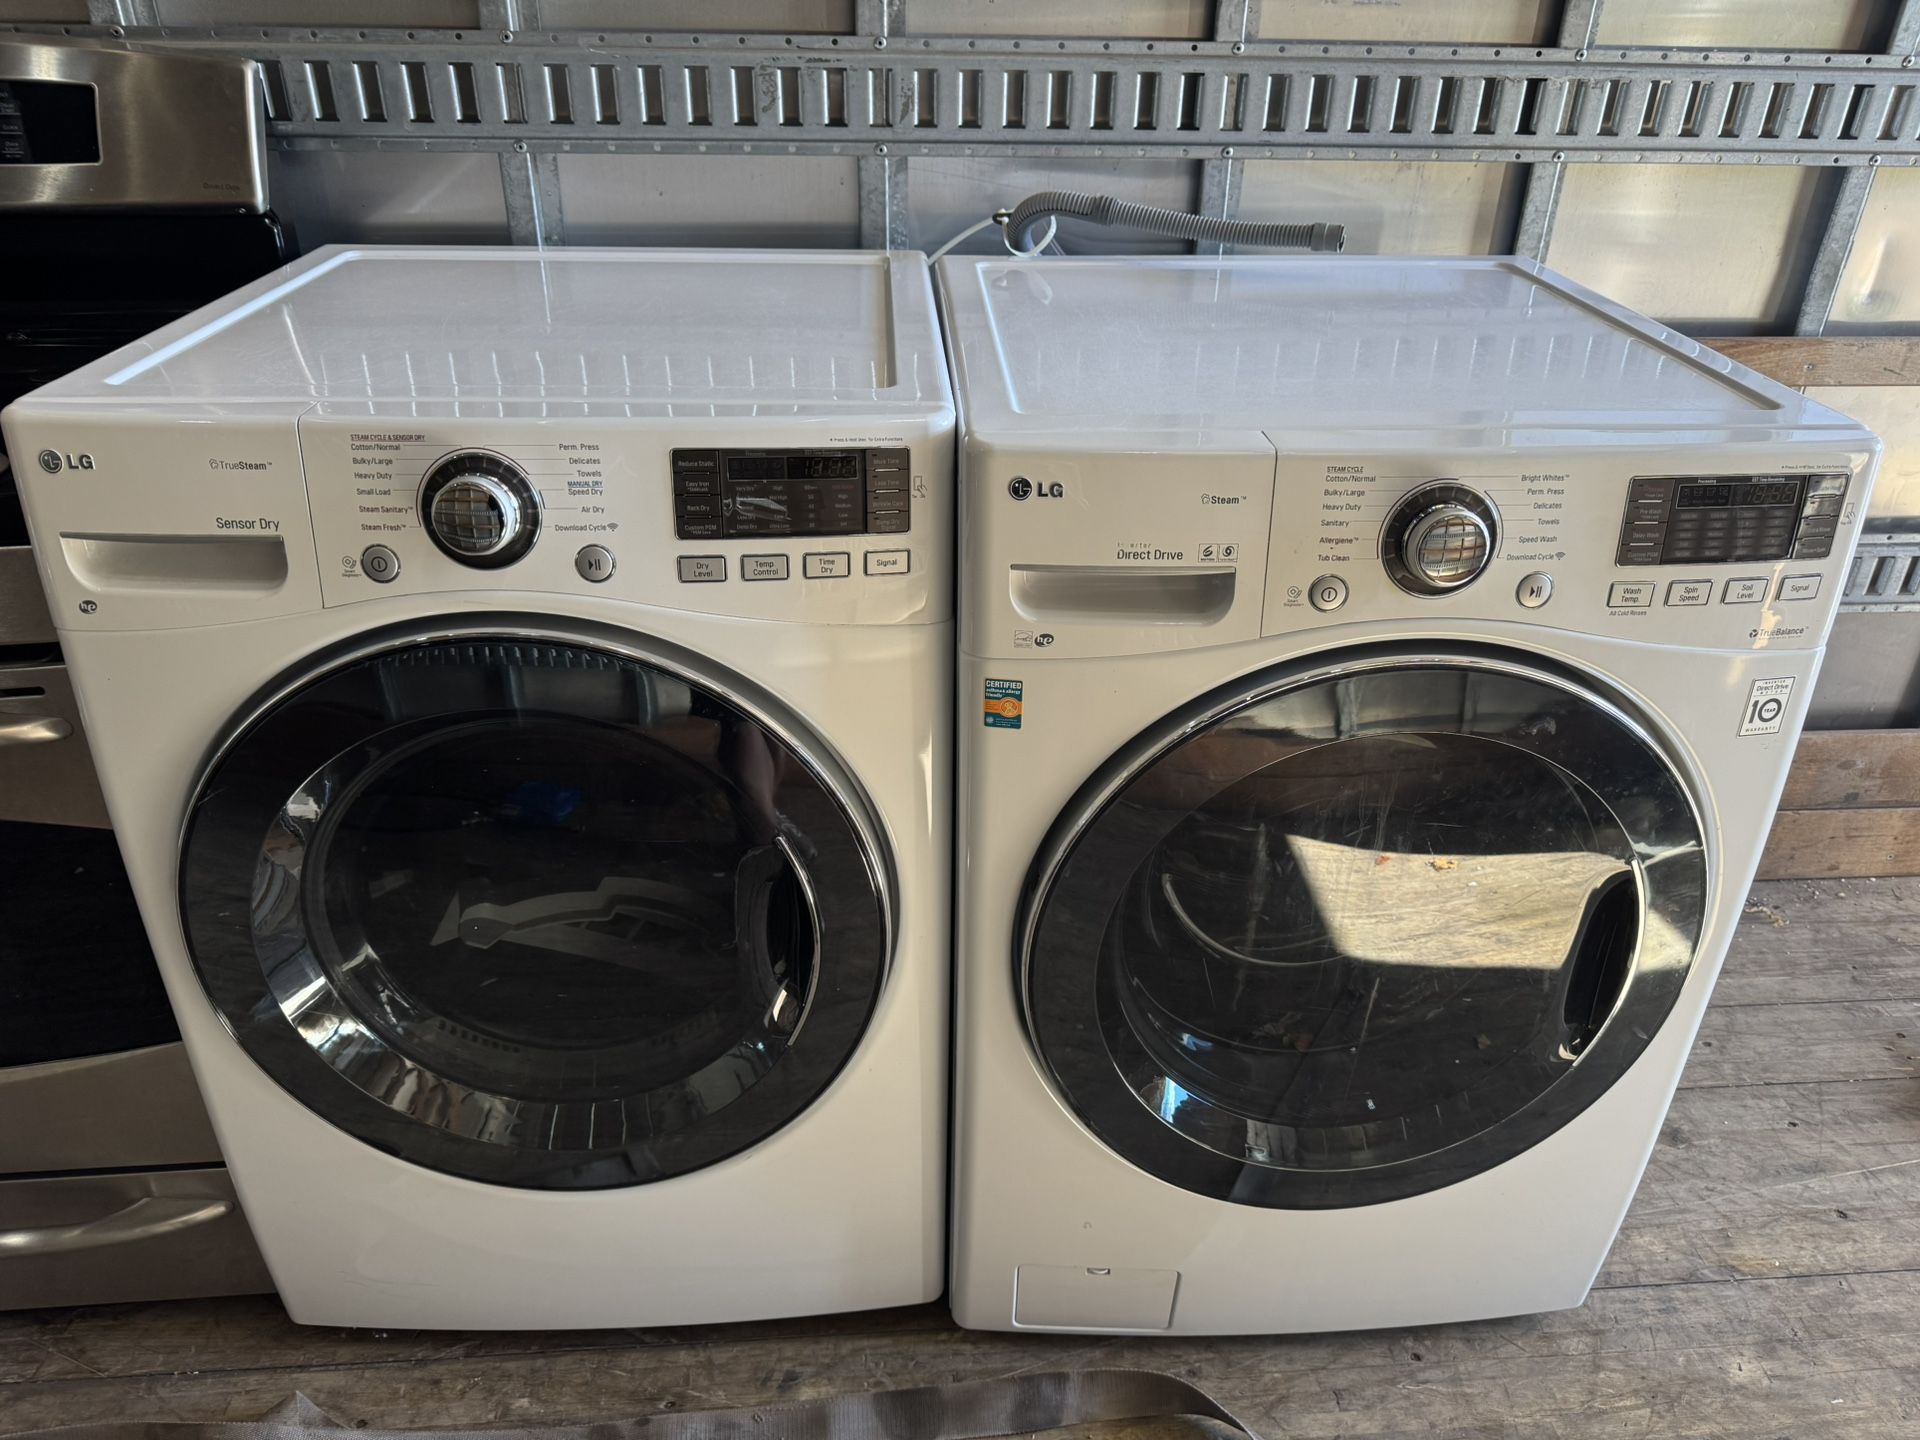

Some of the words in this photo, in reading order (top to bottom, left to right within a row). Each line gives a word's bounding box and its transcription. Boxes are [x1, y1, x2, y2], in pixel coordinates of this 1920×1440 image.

[580, 443, 599, 451] Press
[66, 454, 95, 470] LG
[354, 472, 375, 480] Heavy
[376, 472, 392, 480] Duty
[1521, 475, 1541, 483] Bright
[1038, 482, 1064, 498] LG
[1324, 489, 1365, 497] Bulky/Large
[359, 505, 379, 513] Steam
[592, 506, 604, 514] Dry
[216, 517, 256, 529] Sensor
[259, 518, 280, 532] Dry
[588, 524, 606, 532] Cycle
[1321, 520, 1349, 528] Sanitary
[1519, 536, 1538, 544] Speed
[1117, 549, 1151, 560] Direct
[1154, 549, 1183, 560] Drive
[1537, 553, 1554, 561] Cycle
[696, 562, 709, 570] Dry
[877, 559, 897, 567] Signal
[753, 568, 778, 576] Control
[821, 566, 833, 574] Dry
[1791, 584, 1809, 592] Signal
[987, 680, 1022, 689] CERTIFIED
[1748, 698, 1782, 724] 10
